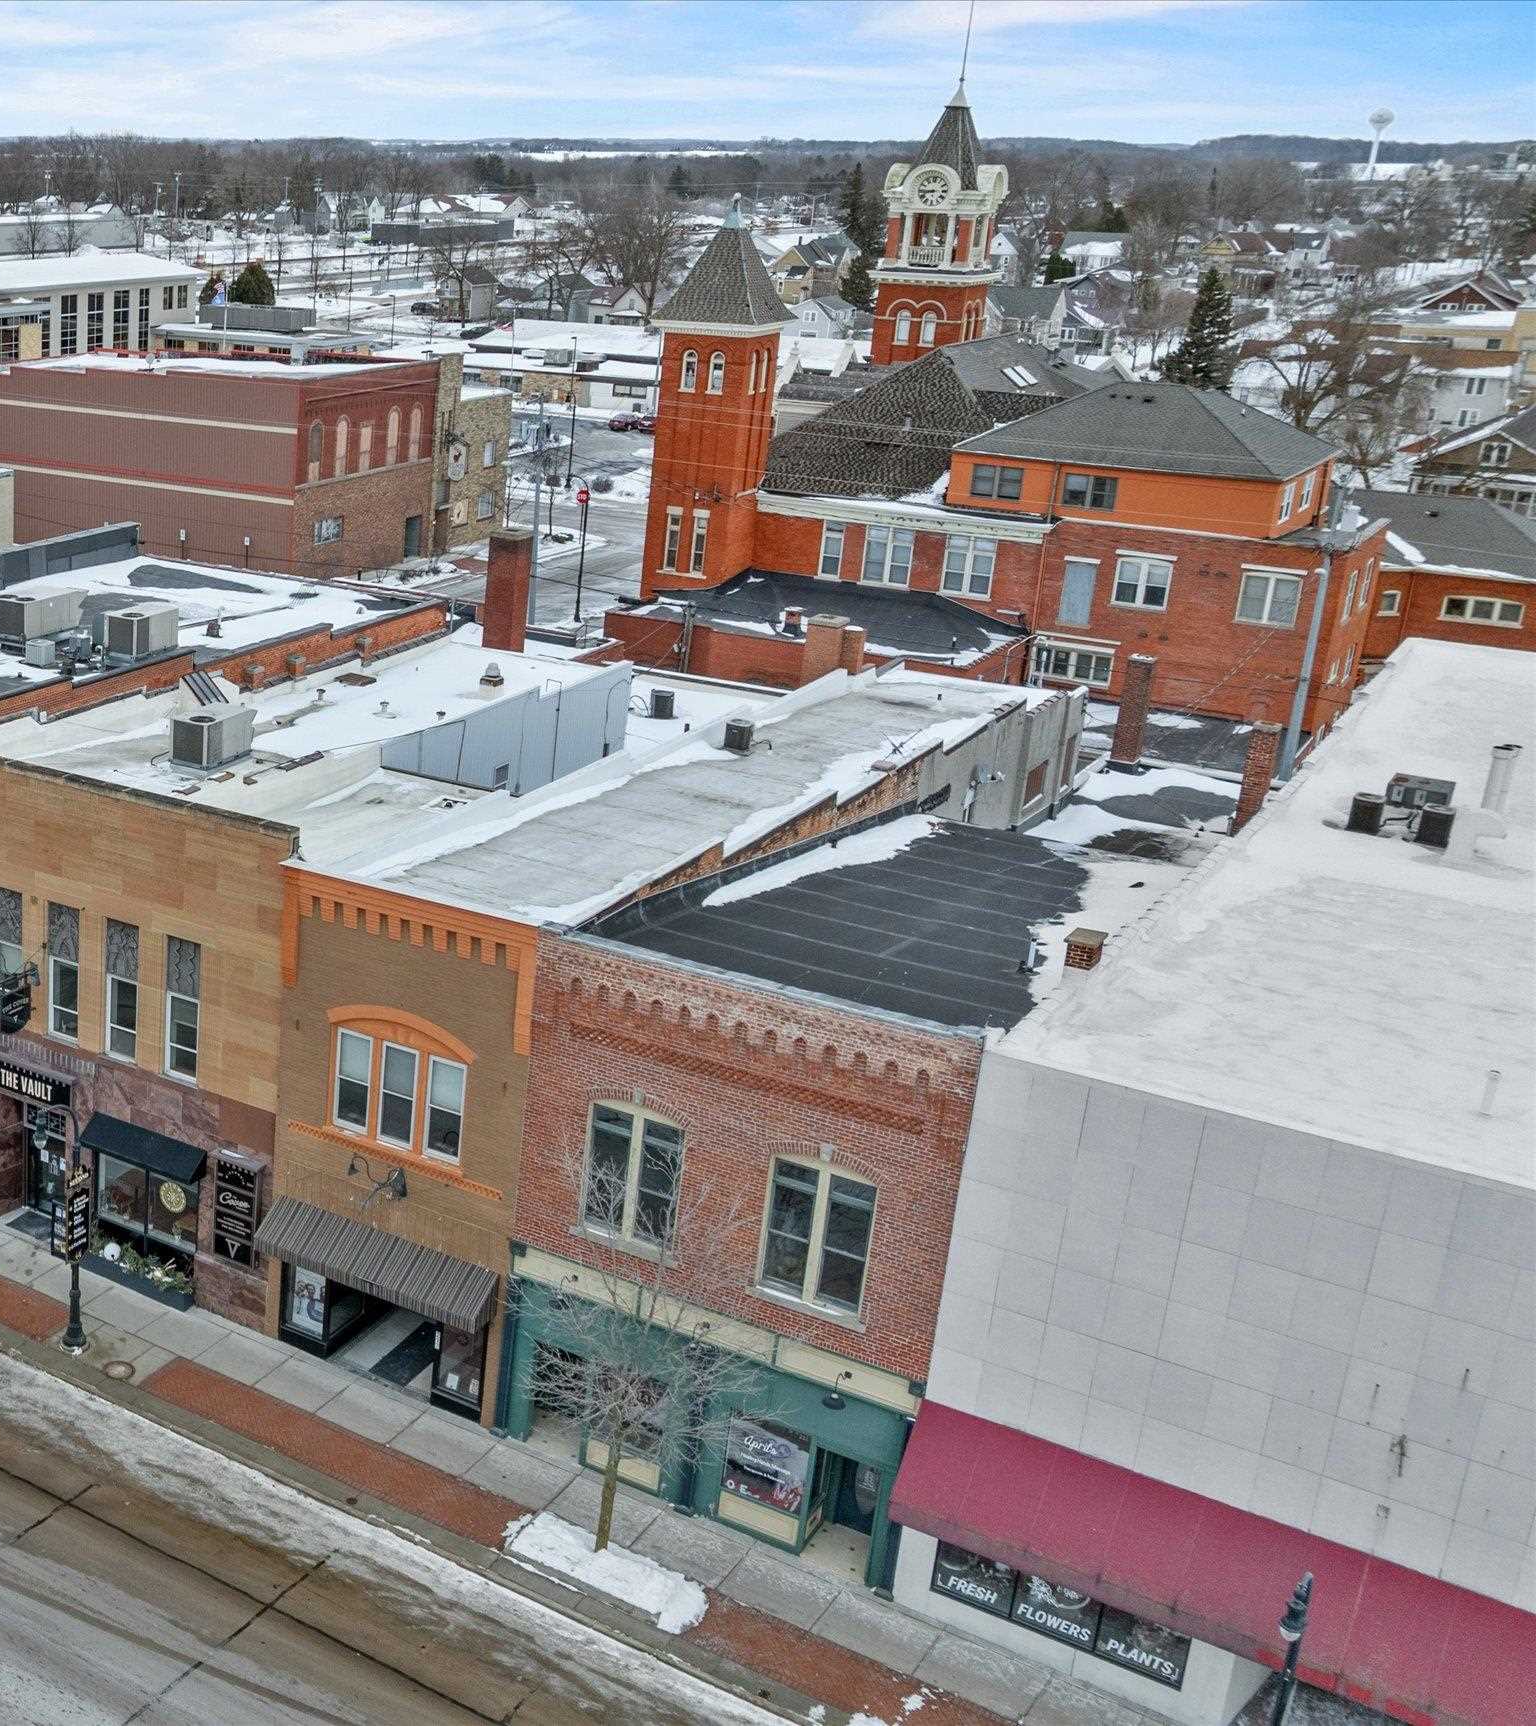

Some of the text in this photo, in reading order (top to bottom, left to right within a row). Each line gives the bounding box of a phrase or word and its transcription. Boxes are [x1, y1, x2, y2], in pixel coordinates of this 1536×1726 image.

[0, 1068, 53, 1103] THE VAULT
[947, 1575, 998, 1605] FRESH
[1017, 1603, 1092, 1642] FLOWERS
[1105, 1638, 1175, 1677] PLANTS
